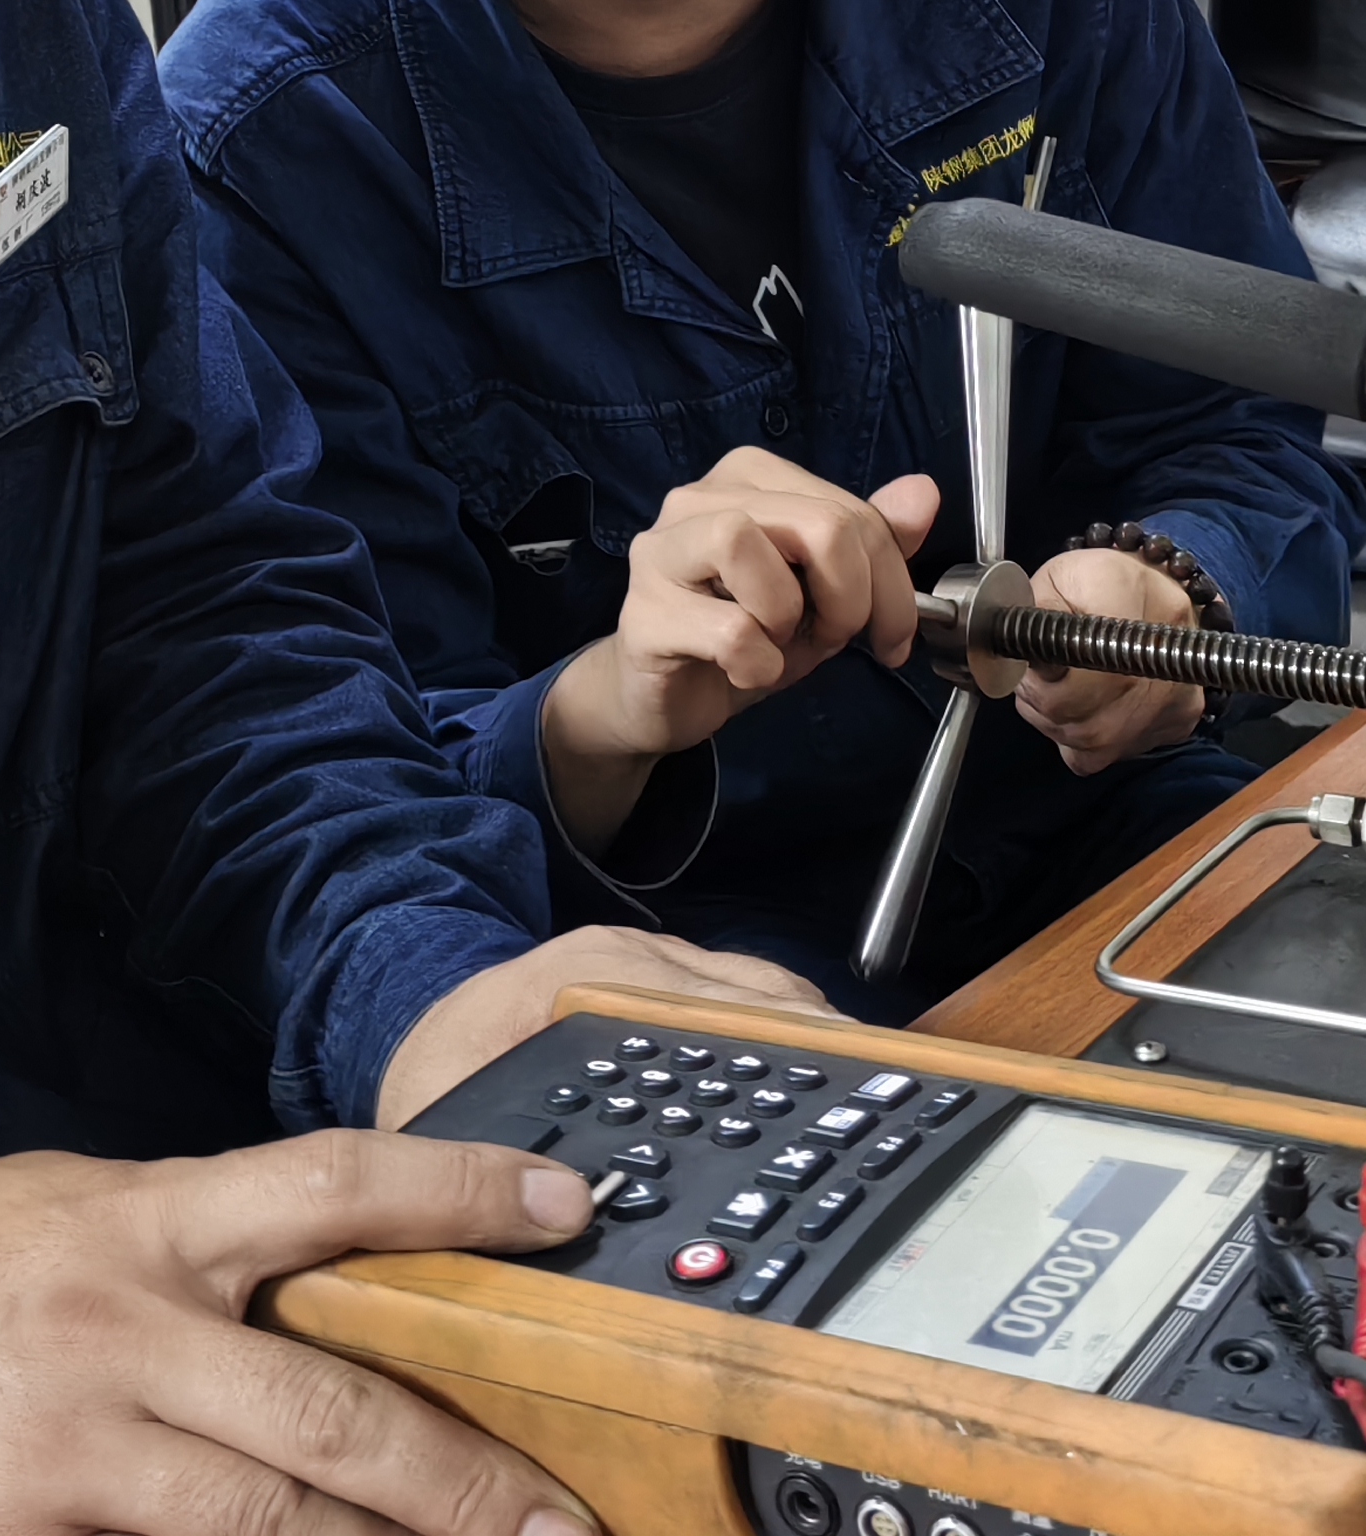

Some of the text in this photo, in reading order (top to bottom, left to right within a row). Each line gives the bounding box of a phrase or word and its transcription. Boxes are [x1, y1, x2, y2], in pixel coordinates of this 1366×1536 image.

[679, 1045, 709, 1058] 7
[586, 1059, 618, 1072] 0
[731, 1055, 762, 1067] 4
[641, 1069, 672, 1082] 8
[788, 1066, 819, 1076] 1
[697, 1079, 729, 1092] 5
[753, 1089, 787, 1102] 2
[933, 1091, 959, 1105] F1
[719, 1117, 753, 1130] 3
[876, 1135, 905, 1152] F2
[818, 1191, 847, 1209] F3
[755, 1259, 786, 1280] F4
[992, 1228, 1121, 1339] 0.0000
